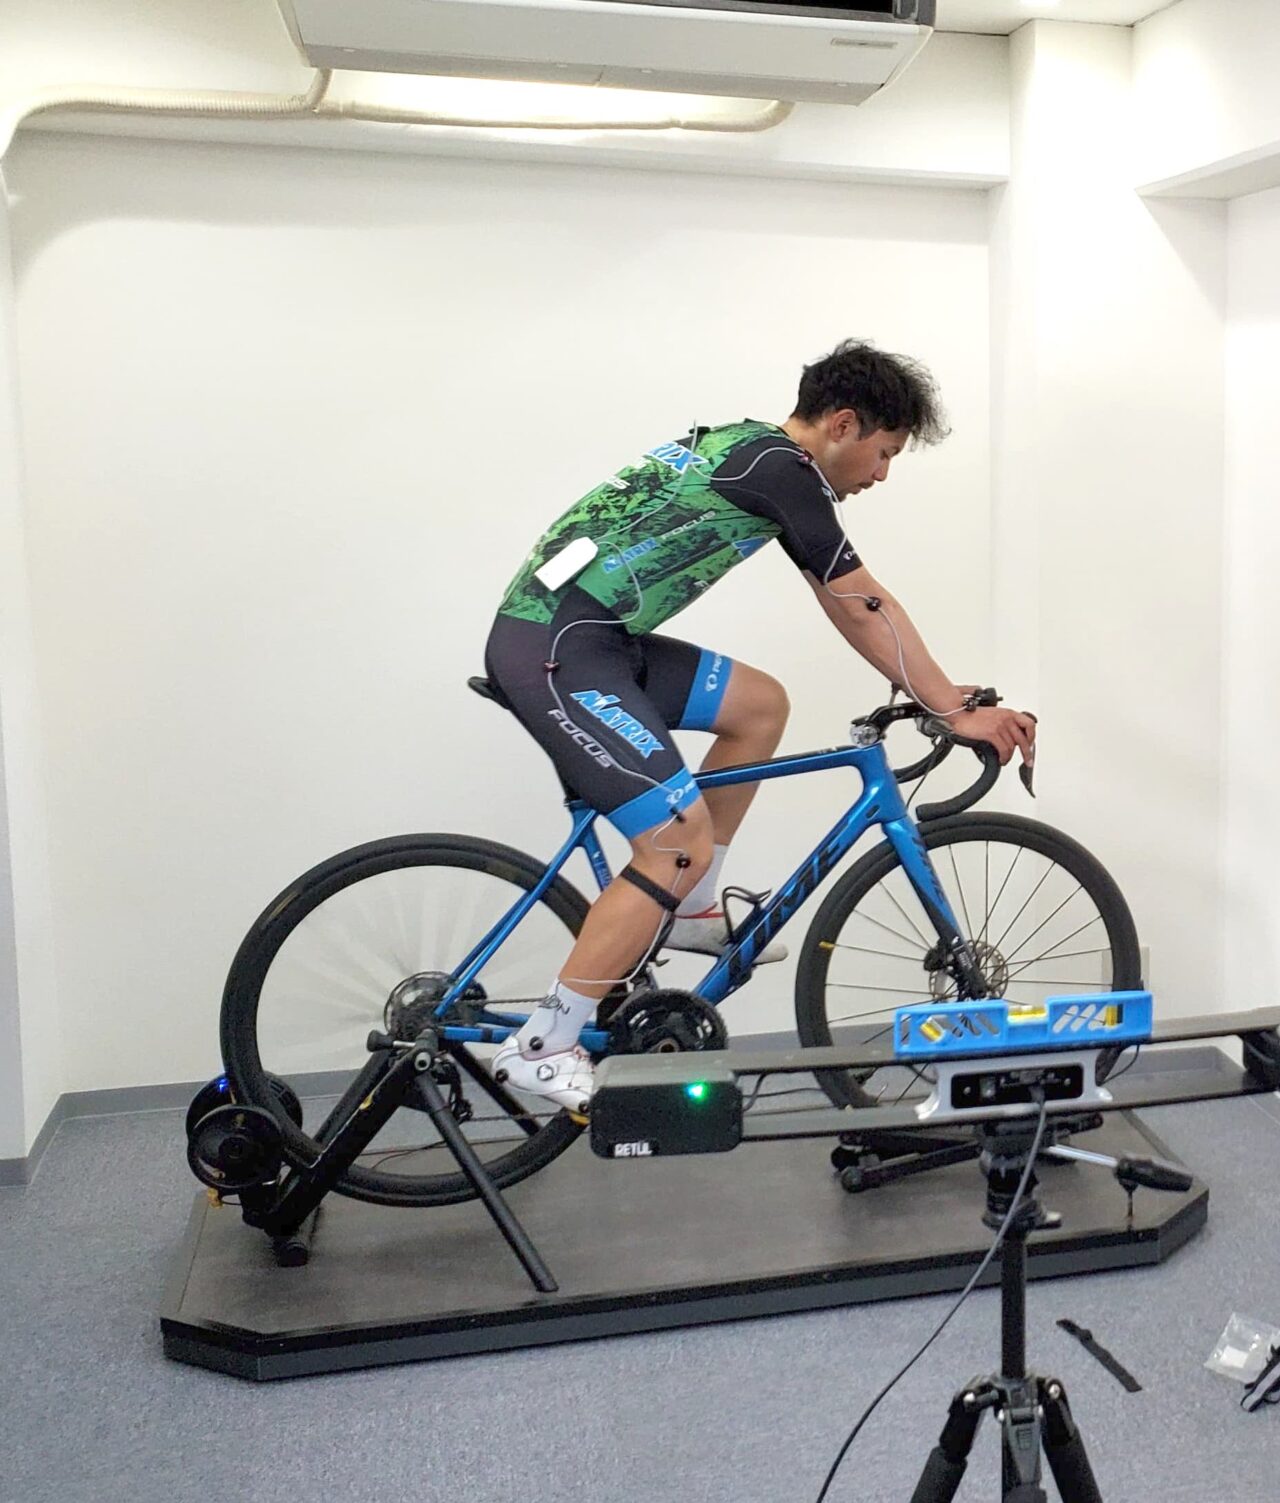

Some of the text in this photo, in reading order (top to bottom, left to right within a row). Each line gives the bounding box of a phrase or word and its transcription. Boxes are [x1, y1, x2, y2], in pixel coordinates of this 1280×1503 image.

[661, 510, 716, 540] FOCUS
[547, 708, 613, 768] FOCUS
[569, 689, 665, 759] MATRIX
